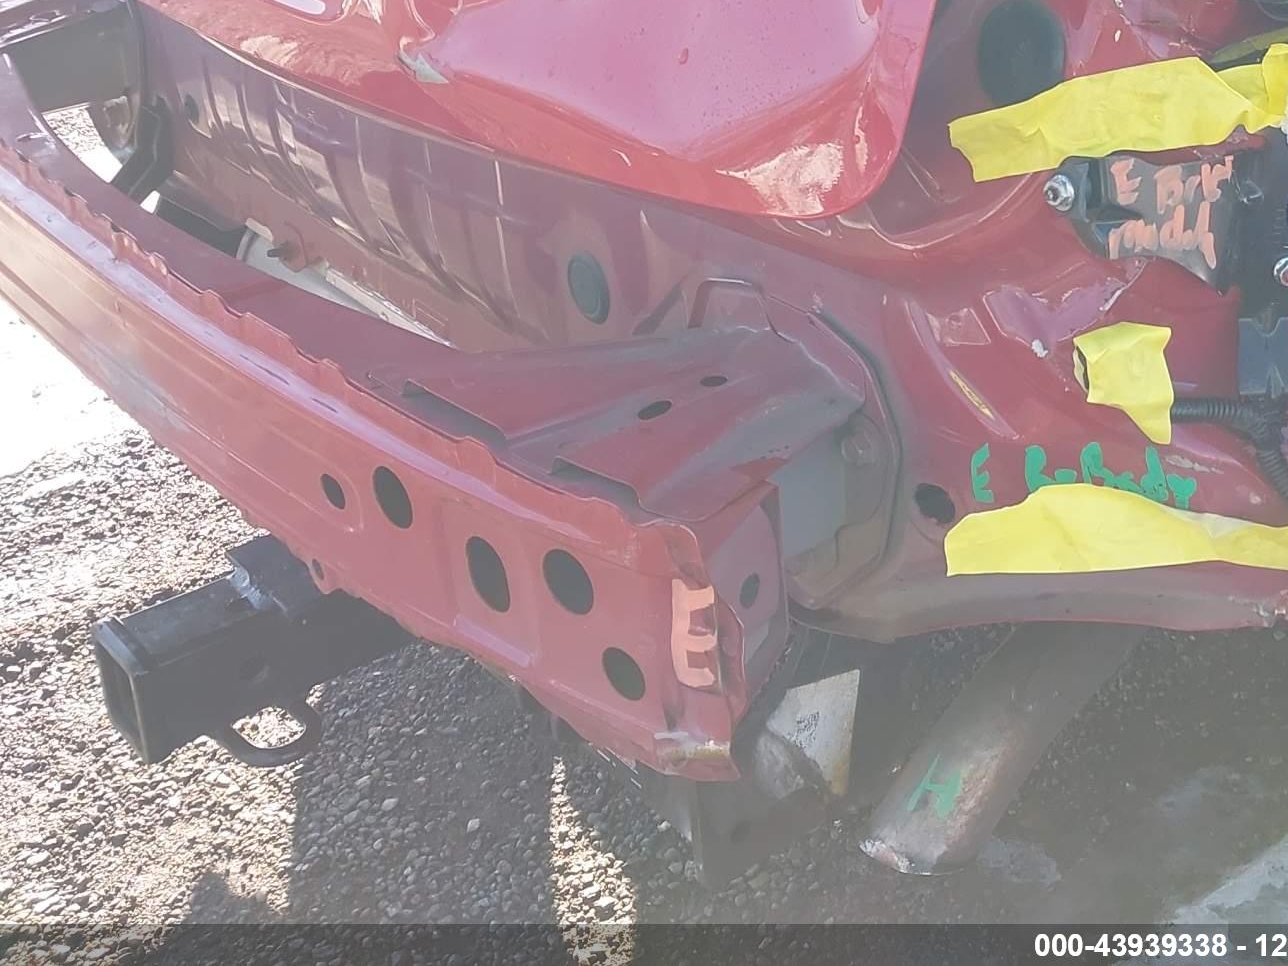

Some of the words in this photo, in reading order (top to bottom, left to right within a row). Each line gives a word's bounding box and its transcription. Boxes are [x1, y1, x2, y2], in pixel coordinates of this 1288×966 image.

[1110, 158, 1142, 206] E
[970, 442, 994, 503] E
[672, 579, 717, 687] E
